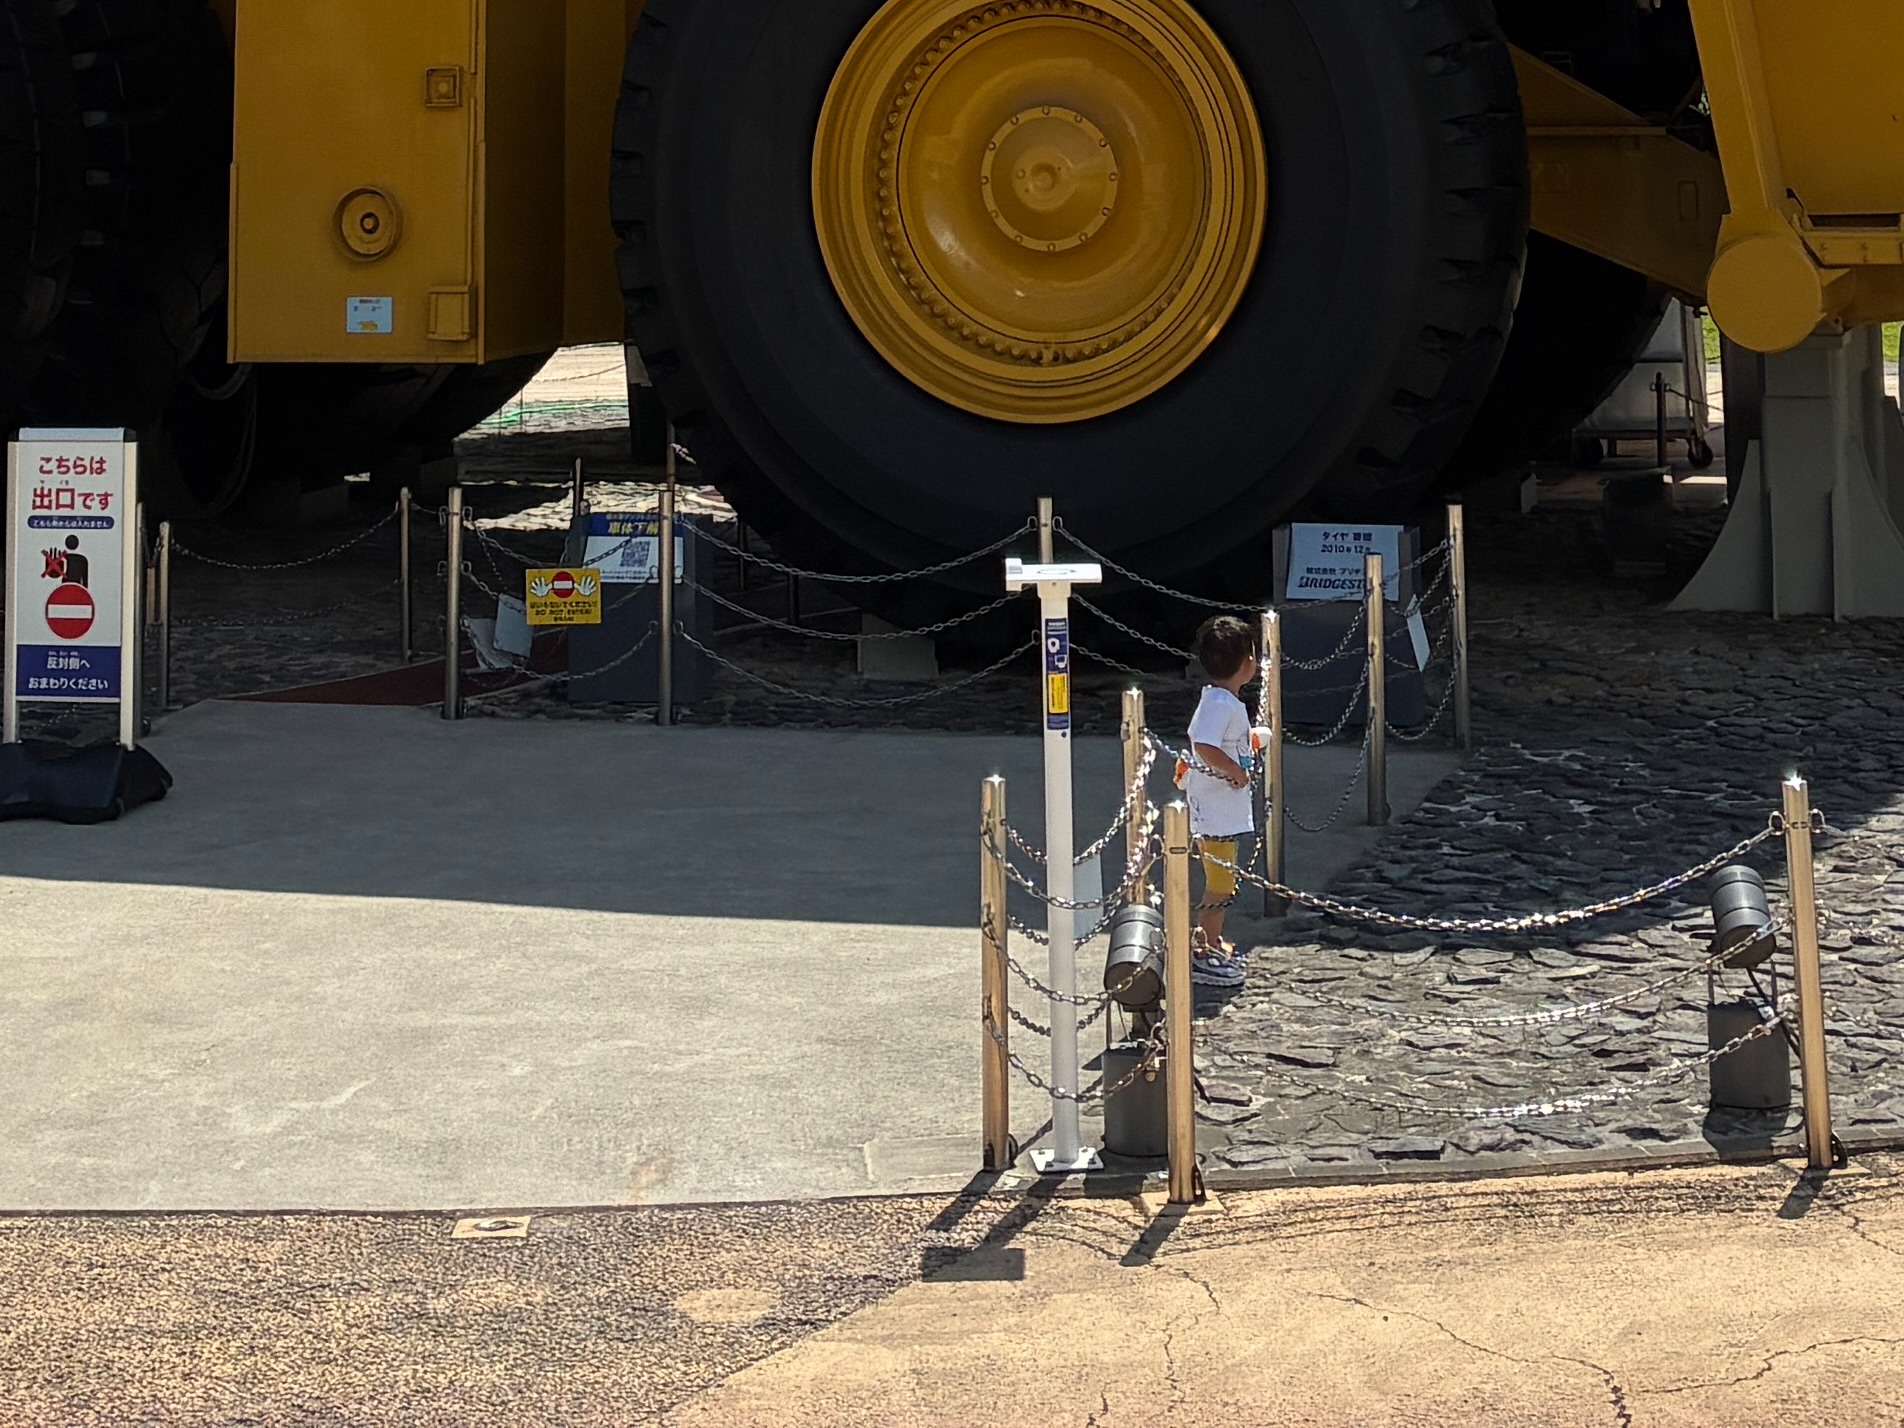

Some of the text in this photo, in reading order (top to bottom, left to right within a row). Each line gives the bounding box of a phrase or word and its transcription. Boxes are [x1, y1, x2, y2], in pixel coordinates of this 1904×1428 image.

[38, 455, 107, 476] こちらは
[31, 485, 114, 511] 出口です
[1322, 531, 1349, 542] タイヤ
[1296, 575, 1366, 590] BRIDGEST
[46, 656, 91, 670] 反対側へ
[28, 677, 109, 690] おまわりください
